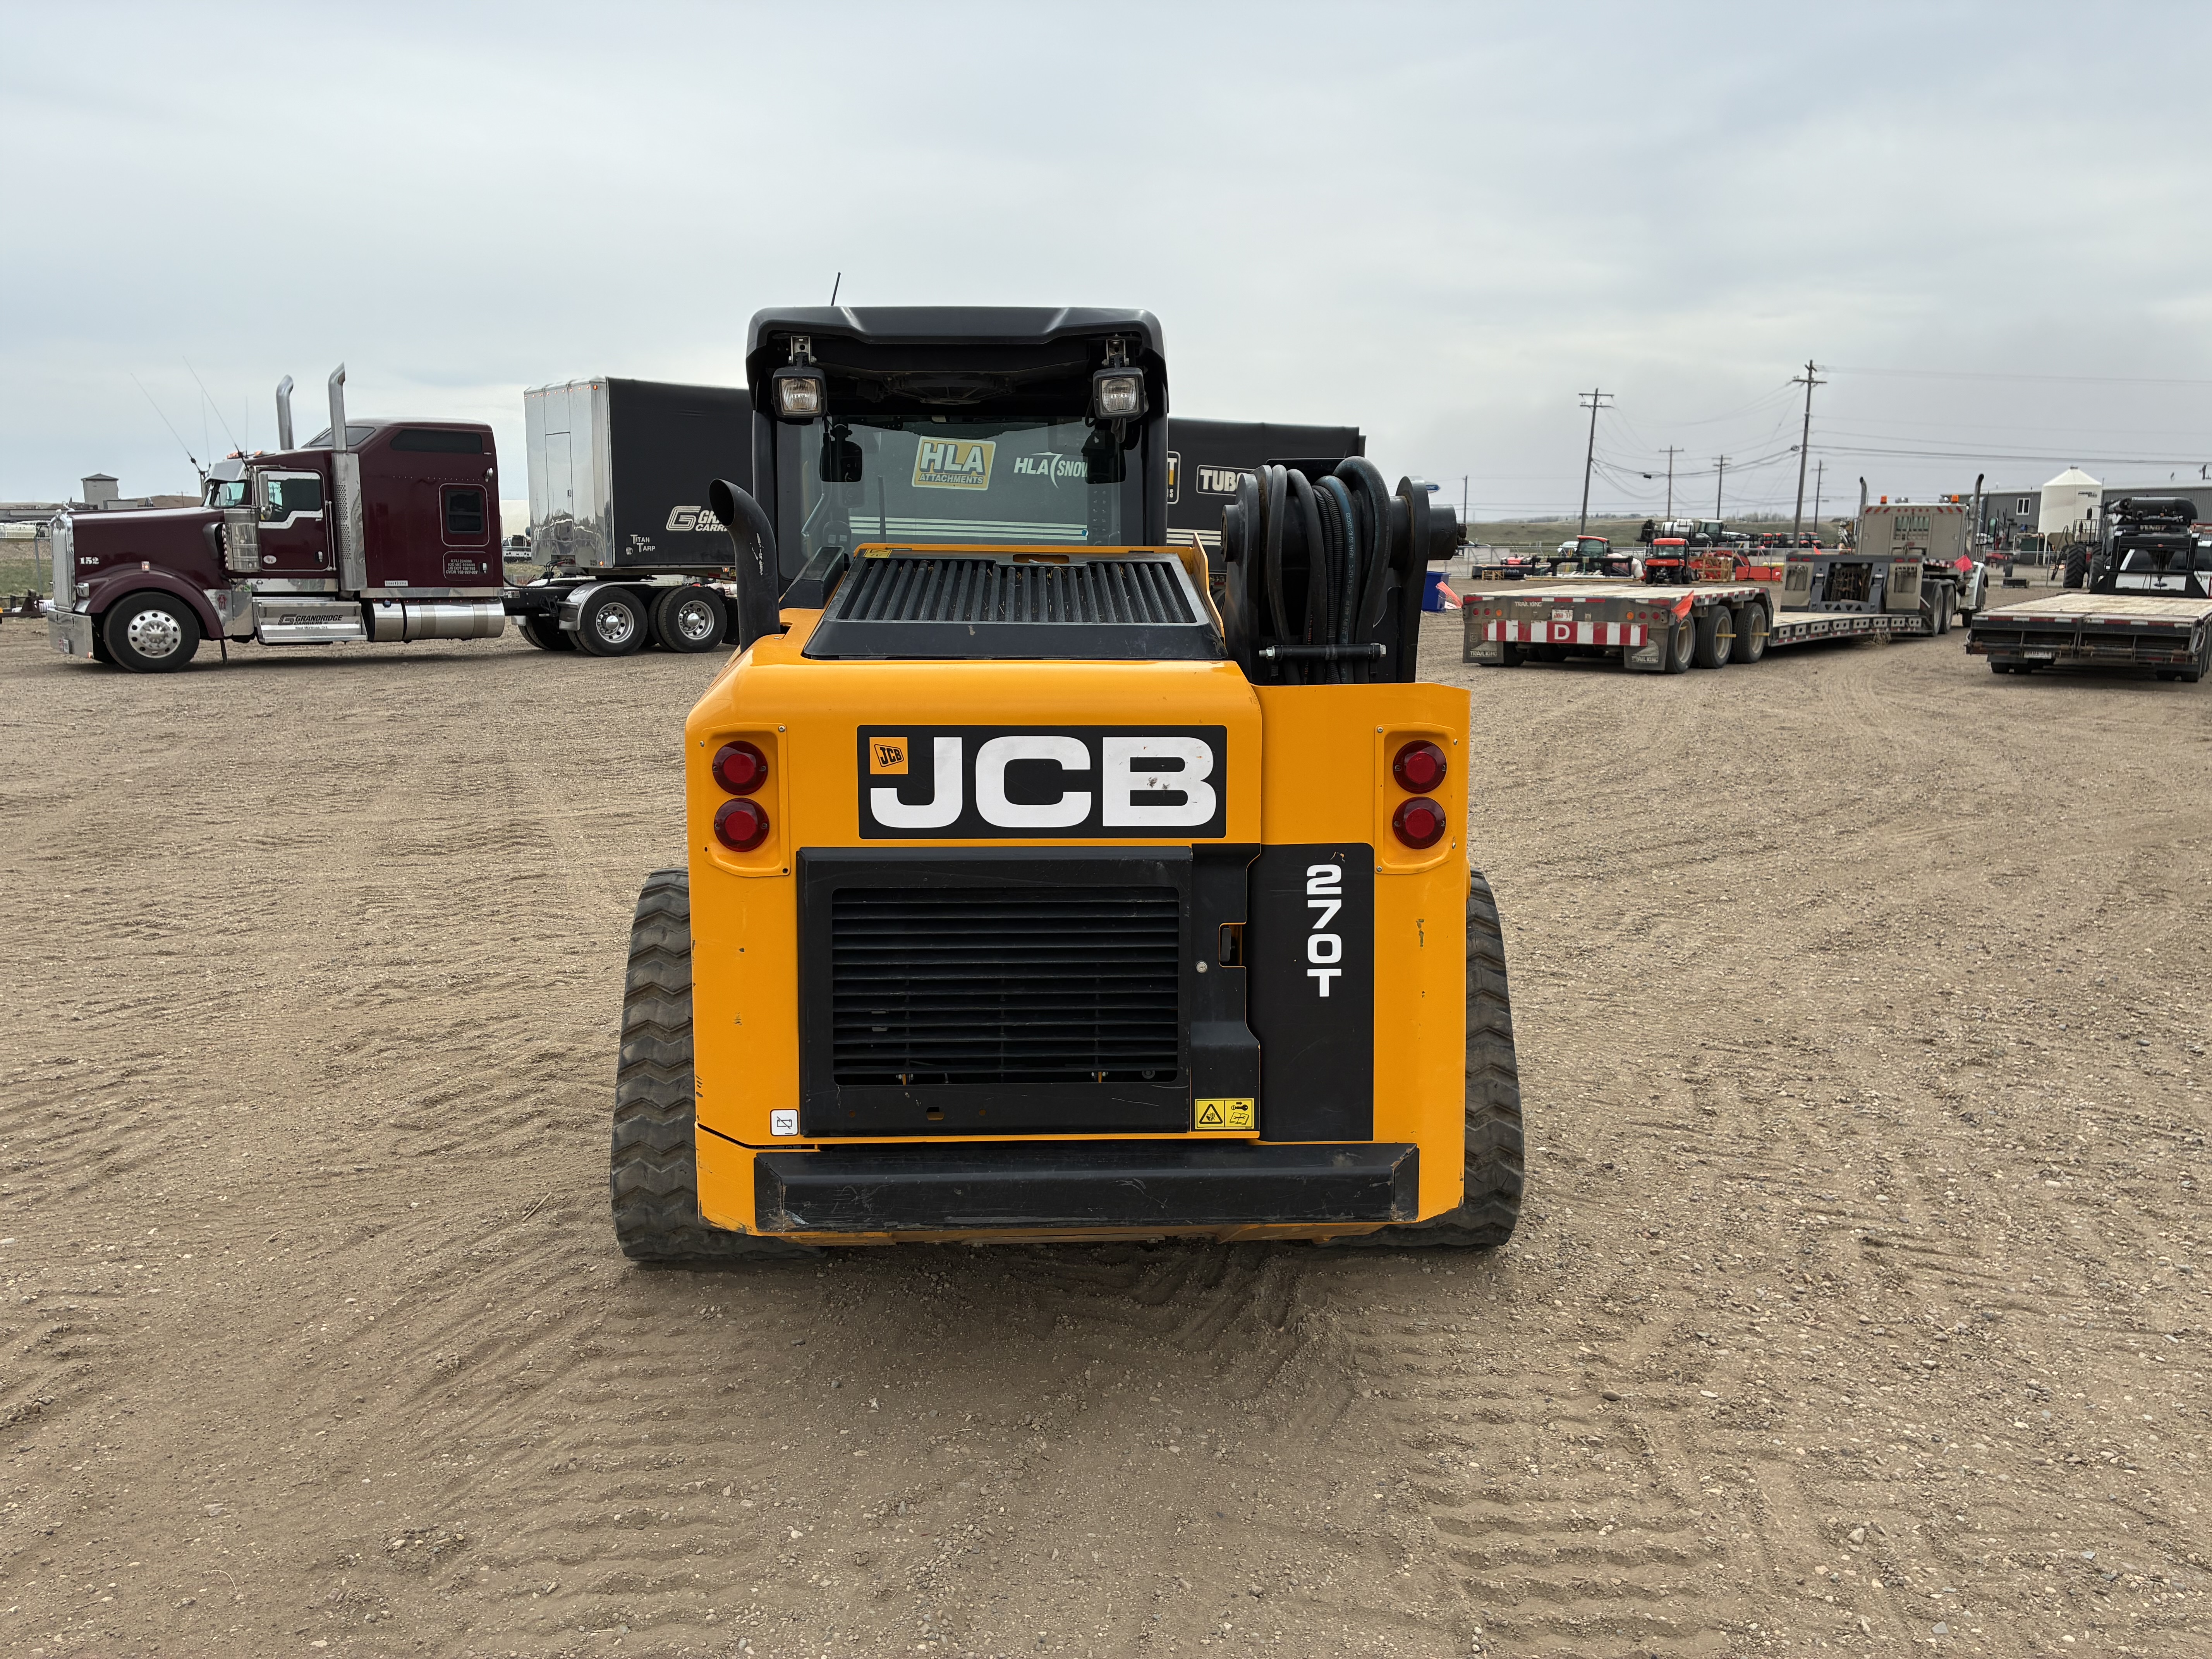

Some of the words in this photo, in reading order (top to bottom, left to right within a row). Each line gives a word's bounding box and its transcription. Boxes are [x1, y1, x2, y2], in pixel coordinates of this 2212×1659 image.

[920, 442, 985, 475] HLA
[1013, 457, 1049, 475] HLA
[919, 473, 984, 484] ATTACHMENTS
[630, 534, 650, 544] TITAN
[636, 543, 656, 553] TARP
[1554, 624, 1570, 640] D
[879, 747, 902, 764] JCB
[871, 736, 1216, 828] JCB
[1307, 864, 1342, 997] 270T
